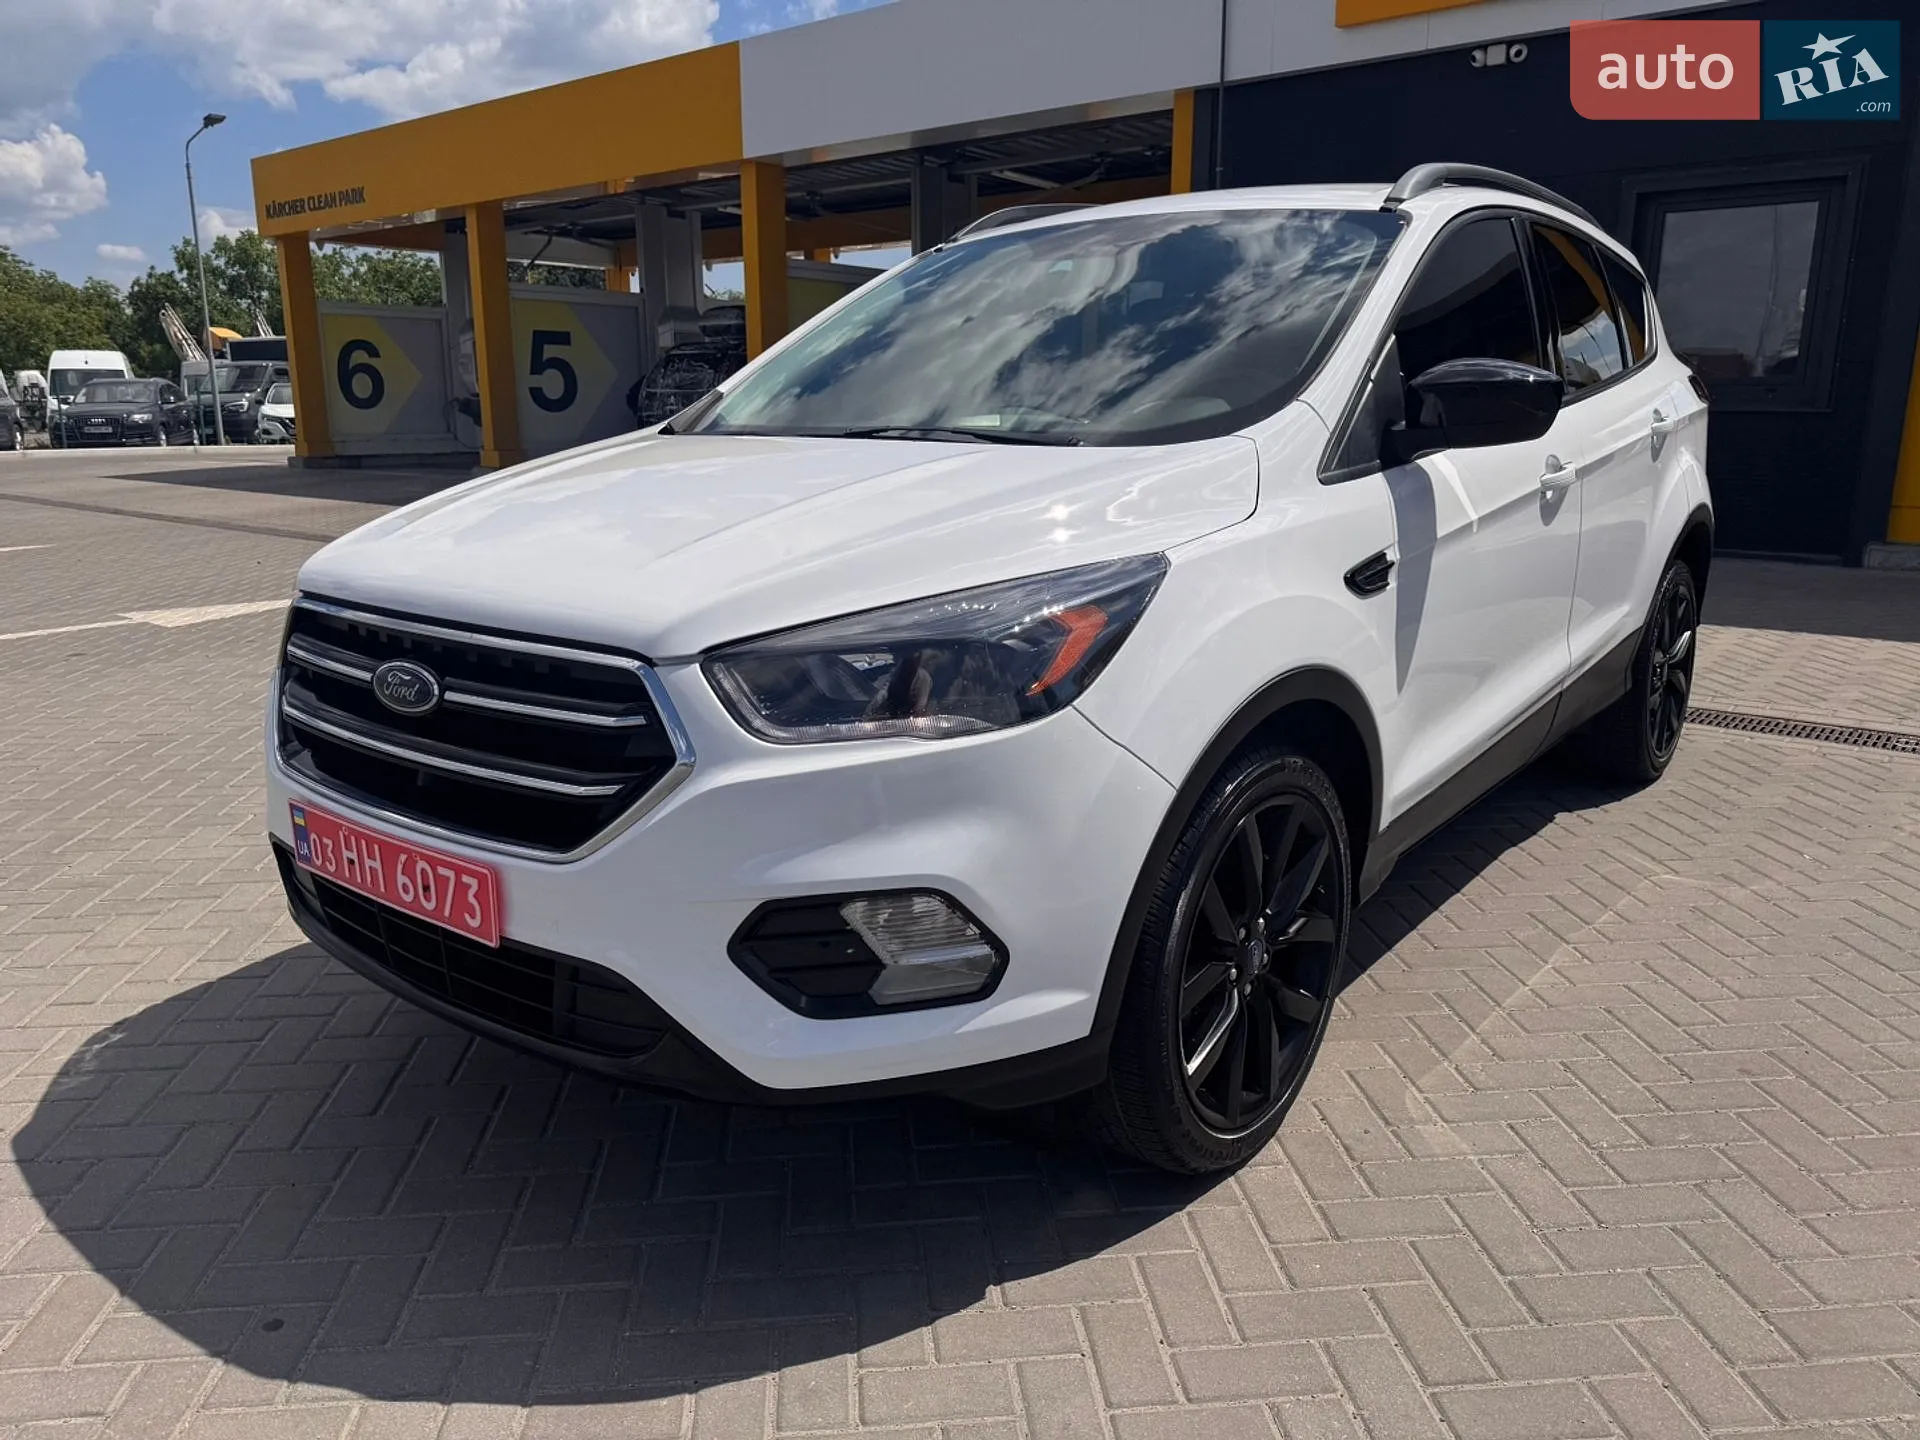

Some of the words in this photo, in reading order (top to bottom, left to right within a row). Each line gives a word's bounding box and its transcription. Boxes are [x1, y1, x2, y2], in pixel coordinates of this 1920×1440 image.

[264, 197, 306, 219] KÄRCHER
[307, 191, 338, 212] CLEAN
[338, 185, 366, 207] PARK
[337, 339, 385, 410] 6
[528, 330, 578, 413] 5
[383, 670, 420, 701] Ford
[297, 839, 311, 856] UA
[310, 832, 337, 873] 03
[396, 853, 482, 929] 6073
